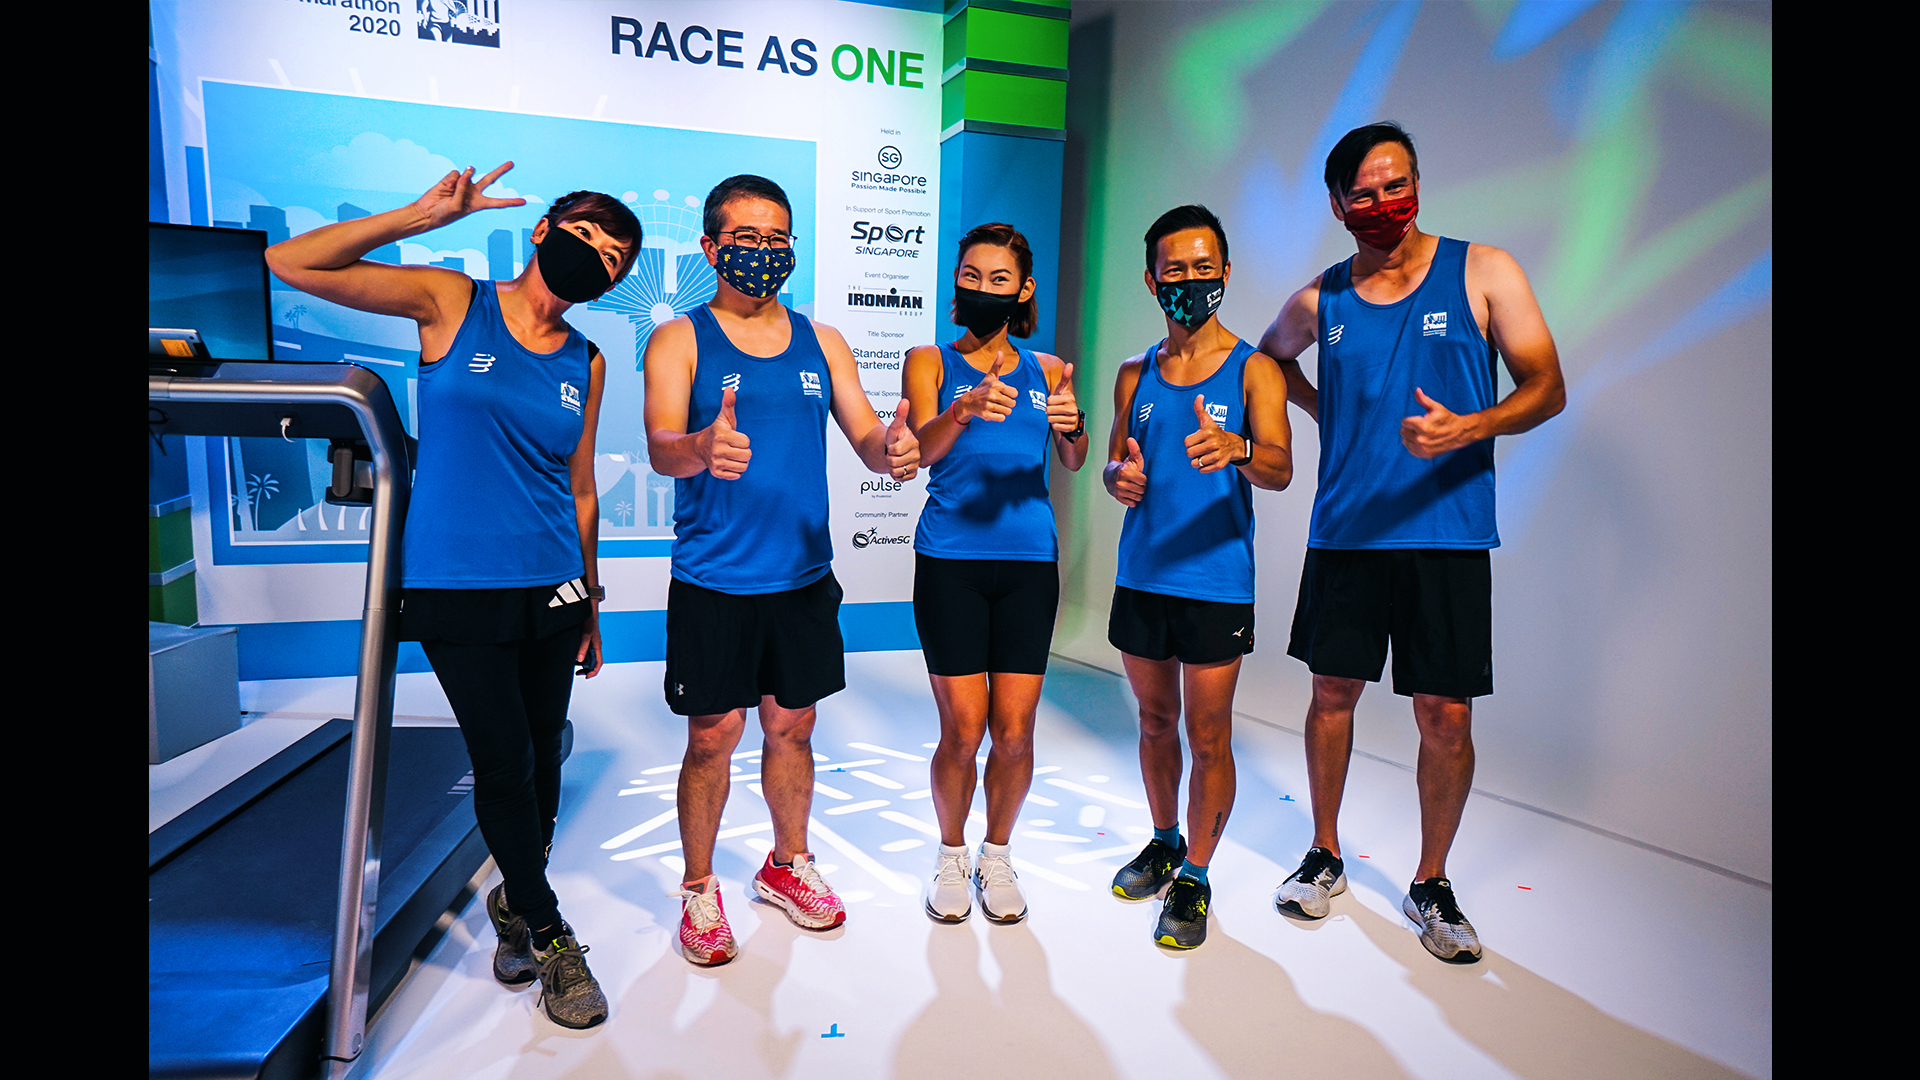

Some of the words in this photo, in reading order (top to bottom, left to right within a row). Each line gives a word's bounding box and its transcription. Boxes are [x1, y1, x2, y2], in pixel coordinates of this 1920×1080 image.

[349, 14, 401, 37] 2020
[611, 15, 744, 69] RACE
[757, 35, 818, 77] AS
[831, 43, 925, 89] ONE
[881, 152, 899, 163] SG
[851, 182, 877, 190] Passion
[901, 209, 932, 217] Promotion
[850, 221, 926, 245] Sport
[855, 246, 919, 259] SINGAPORE
[847, 287, 923, 309] IRONMAN
[852, 348, 900, 359] Standard
[856, 360, 900, 370] hartered
[860, 476, 902, 494] pulse
[869, 535, 911, 544] ActiveSG
